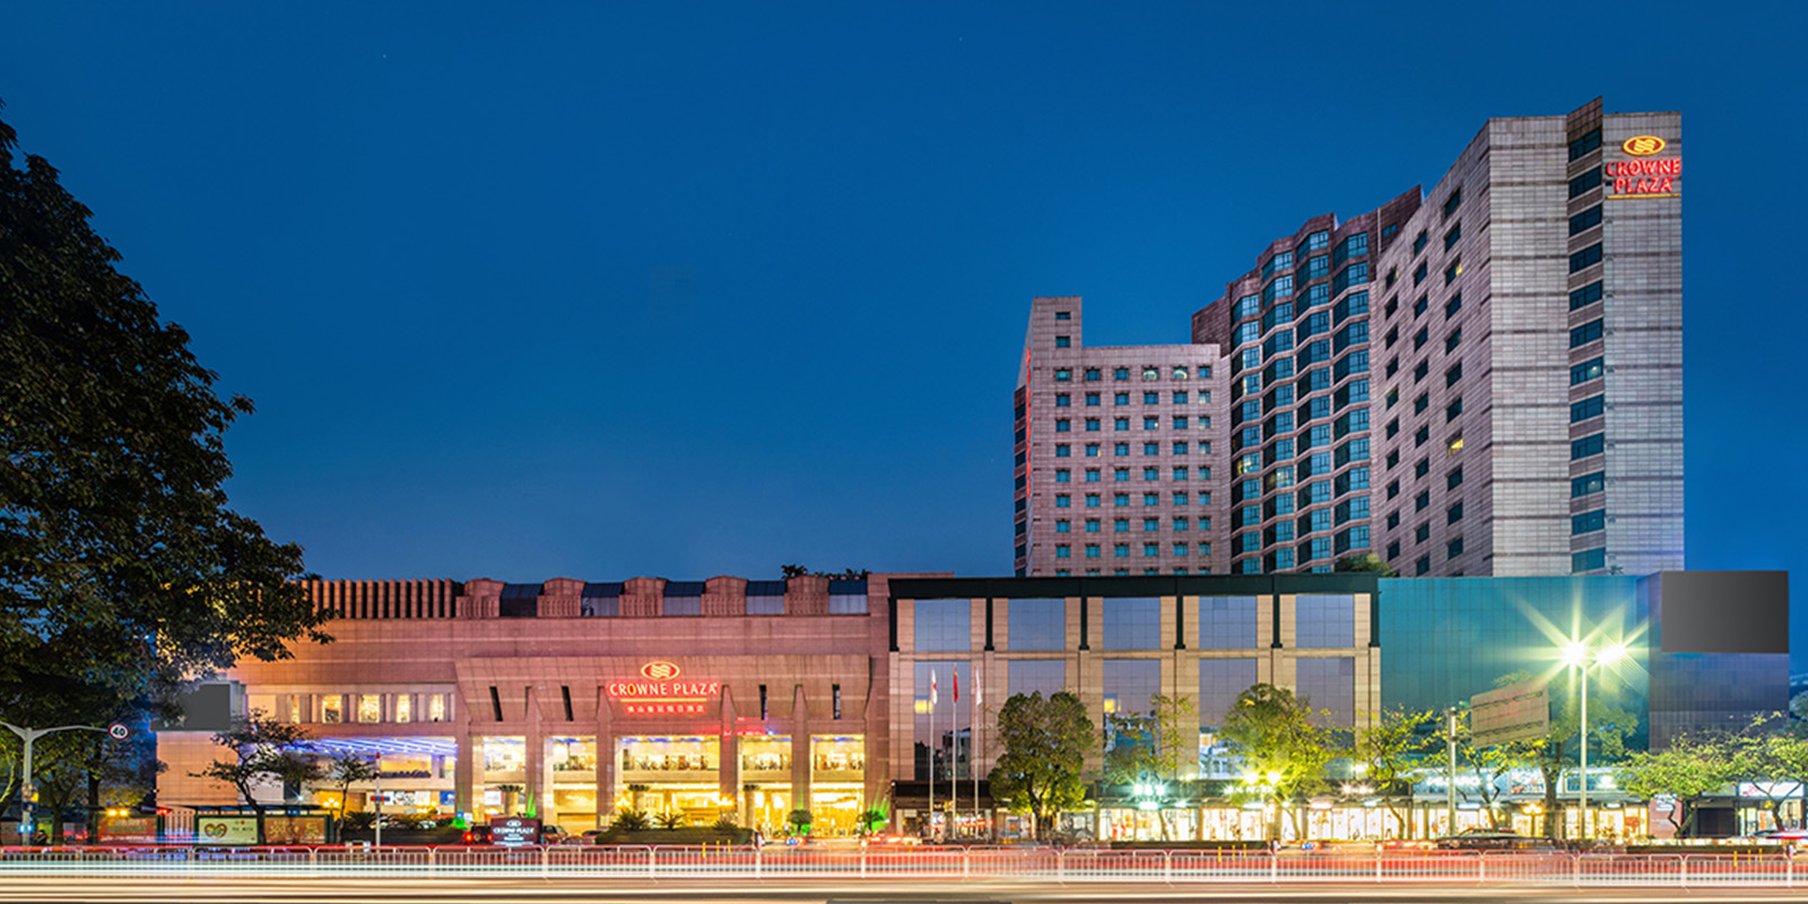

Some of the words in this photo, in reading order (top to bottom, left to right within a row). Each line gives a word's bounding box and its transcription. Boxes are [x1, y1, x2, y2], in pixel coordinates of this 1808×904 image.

[1605, 158, 1681, 176] CROWNE
[1614, 177, 1674, 194] PLAZA
[609, 683, 668, 696] CROWNE
[673, 683, 717, 696] PLAZA
[112, 726, 126, 737] 40
